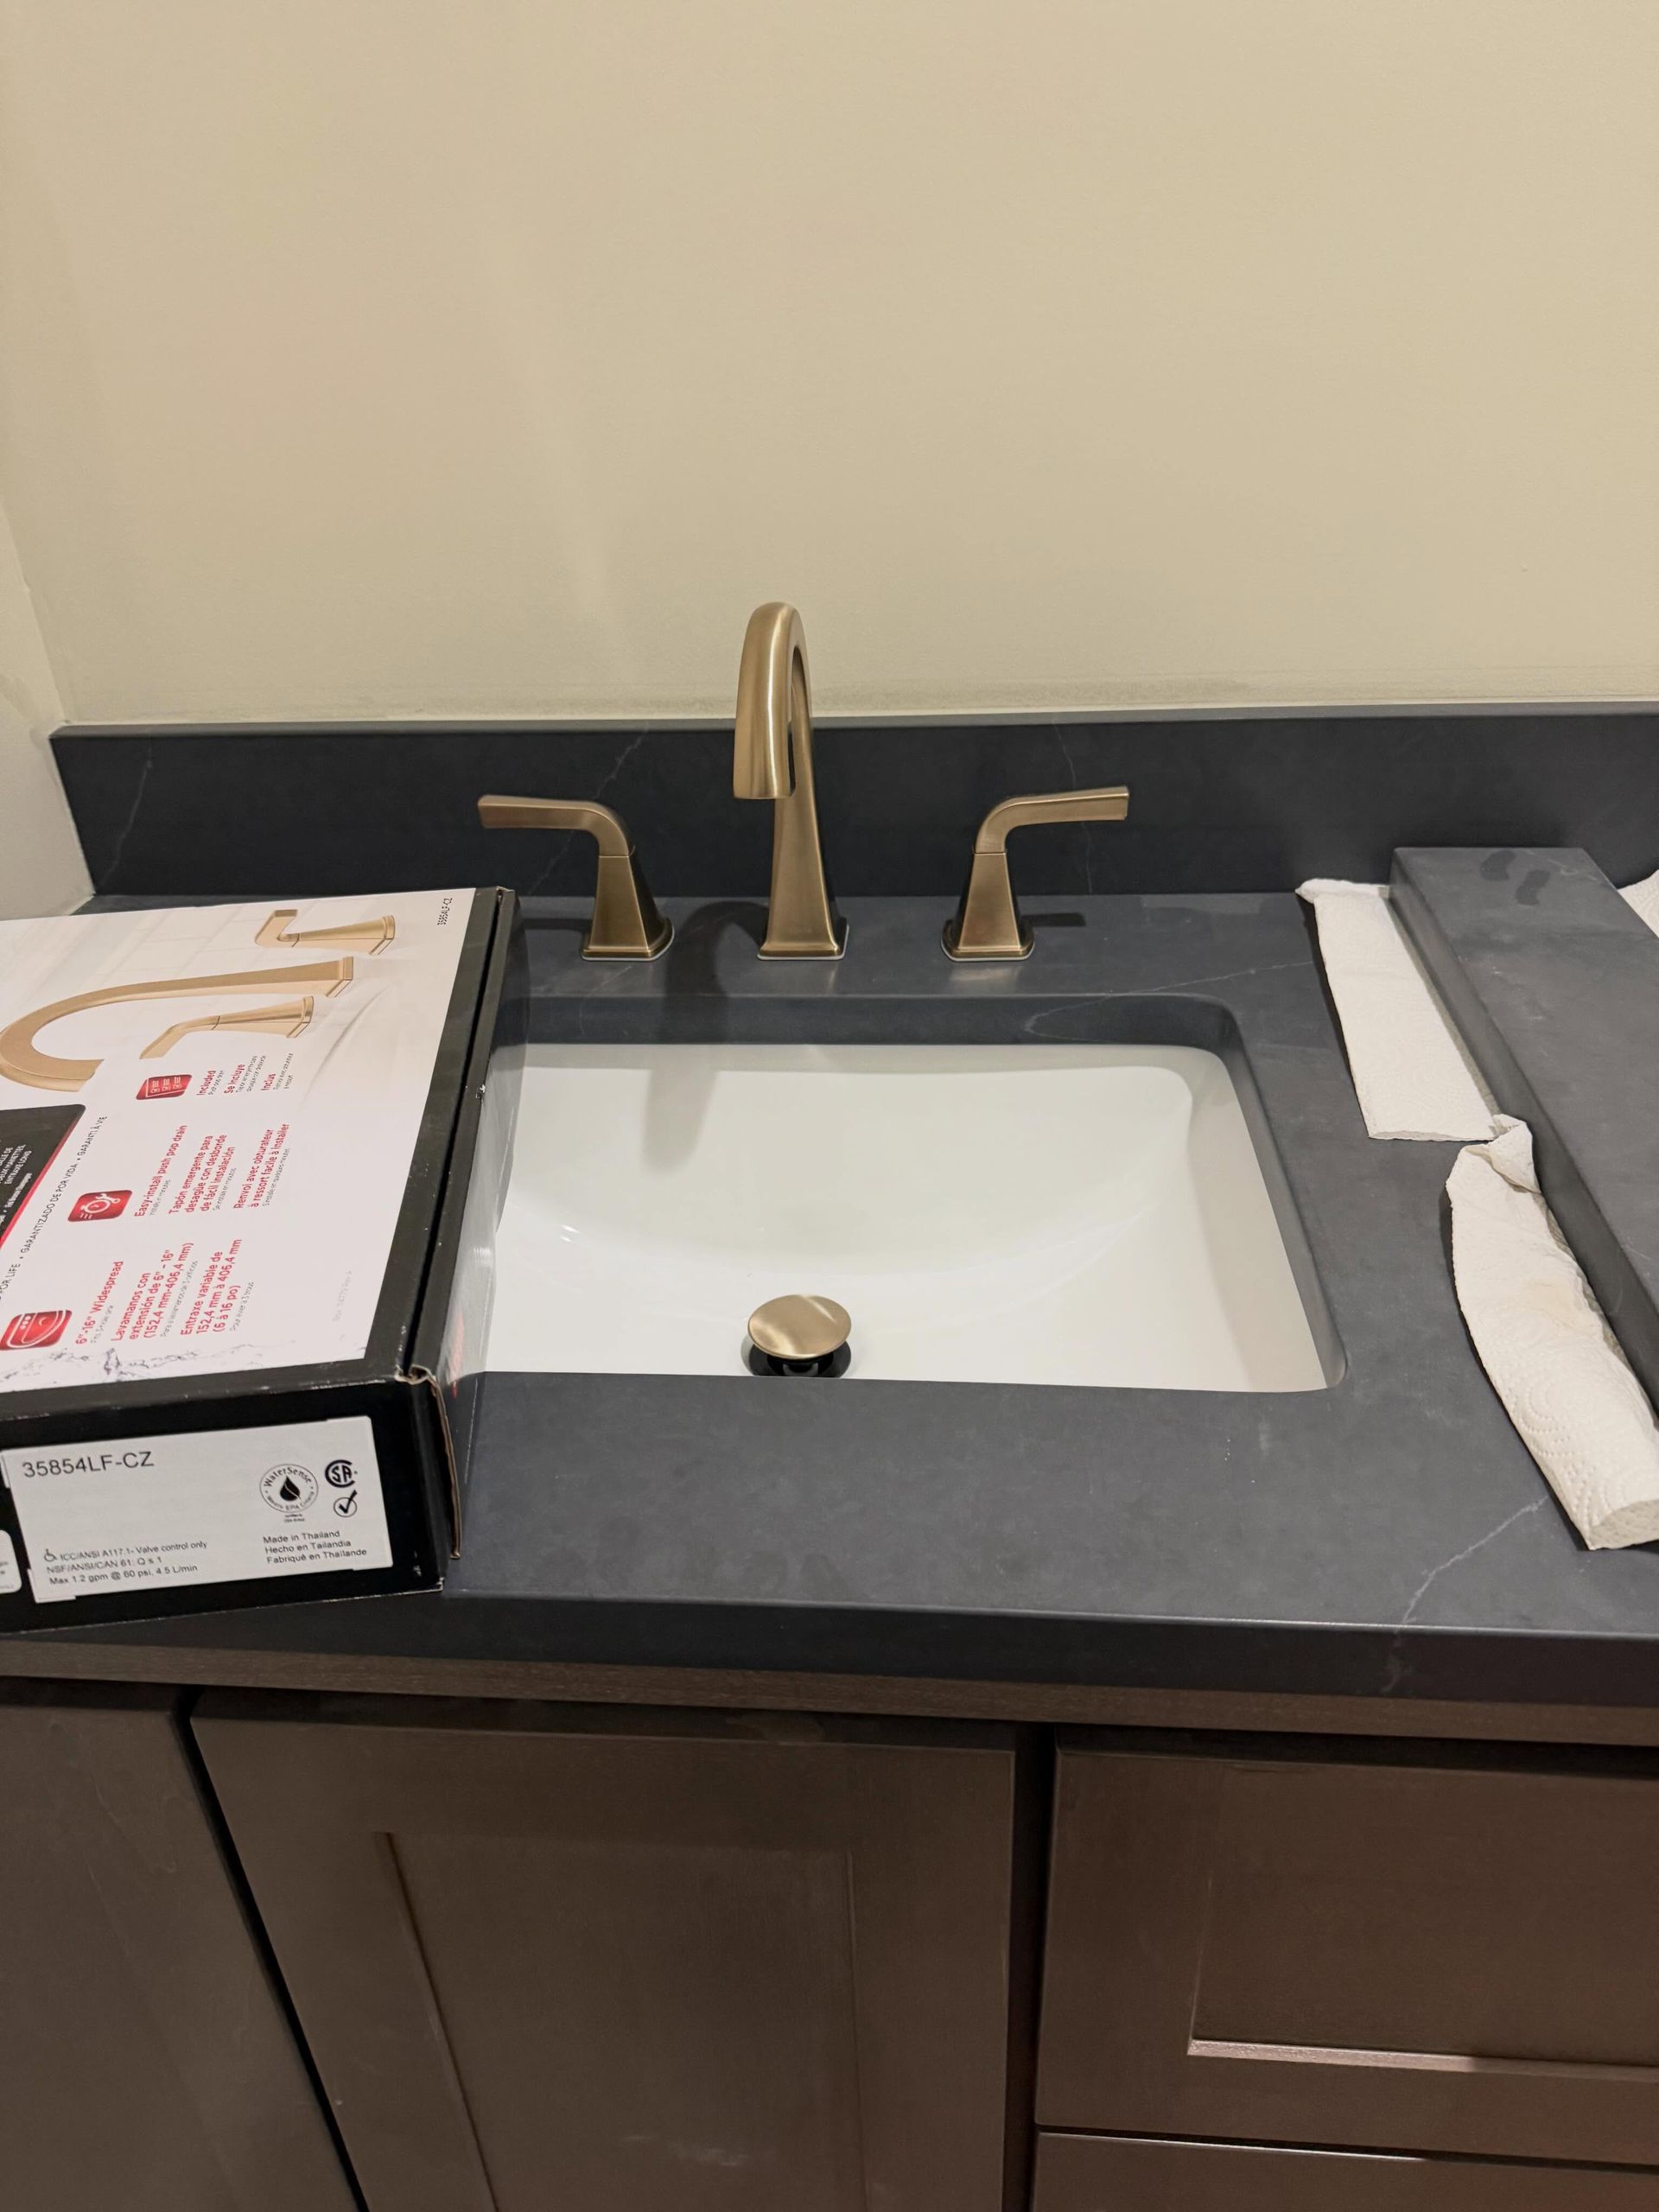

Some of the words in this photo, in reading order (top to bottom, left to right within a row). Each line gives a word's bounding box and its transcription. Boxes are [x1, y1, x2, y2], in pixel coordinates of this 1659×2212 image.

[196, 1071, 216, 1096] Included
[77, 1130, 98, 1156] GARANTI
[252, 1129, 274, 1165] obturateur
[270, 1124, 289, 1149] installer
[206, 1135, 227, 1166] desborde
[63, 1163, 78, 1180] VIDA
[134, 1175, 162, 1217] Easy-install
[157, 1158, 172, 1174] push
[166, 1142, 180, 1156] pop
[173, 1125, 188, 1141] drain
[168, 1191, 188, 1214] Tapón
[182, 1152, 206, 1189] emergente
[200, 1135, 213, 1151] para
[200, 1167, 213, 1180] con
[211, 1147, 235, 1184] instalación
[246, 1166, 259, 1182] avec
[261, 1156, 277, 1175] facile
[50, 1193, 61, 1202] DE
[55, 1180, 69, 1192] POR
[184, 1182, 206, 1212] desagüe
[203, 1185, 219, 1200] fácil
[233, 1184, 252, 1209] Renvoi
[253, 1176, 270, 1201] ressort
[200, 1202, 212, 1211] de
[21, 1204, 55, 1253] GARANTIZADO
[5, 1264, 21, 1278] LIFE
[90, 1262, 124, 1313] Widespread
[143, 1311, 165, 1338] (152,4
[158, 1263, 183, 1308] mm-406,4
[178, 1243, 194, 1262] mm)
[180, 1300, 203, 1335] Entraxe
[197, 1264, 218, 1299] variable
[211, 1251, 223, 1262] de
[196, 1310, 215, 1333] 152,4
[209, 1291, 222, 1307] mm
[218, 1256, 235, 1281] 406,4
[229, 1239, 242, 1255] mm
[227, 1285, 241, 1300] po)
[111, 1290, 143, 1341] Lavamanos
[137, 1273, 151, 1288] con
[130, 1296, 156, 1339] extensión
[149, 1283, 161, 1294] de
[219, 1302, 233, 1313] 16
[213, 1322, 226, 1332] (6
[22, 1451, 155, 1478] 35854LF-CZ
[263, 1466, 312, 1487] WaterSense
[136, 1546, 159, 1554] Valve
[161, 1542, 189, 1553] control
[190, 1541, 207, 1550] only
[263, 1535, 289, 1544] Made
[302, 1530, 340, 1539] Thailand
[265, 1546, 295, 1554] Hecho
[311, 1540, 352, 1549] Tailandia
[47, 1560, 118, 1574] NSF/ANSI/CAN
[137, 1557, 146, 1566] Q
[266, 1554, 307, 1564] Fabriqué
[49, 1576, 70, 1586] Max
[89, 1573, 109, 1584] gpm
[111, 1571, 122, 1581] @
[173, 1564, 198, 1574] L/min
